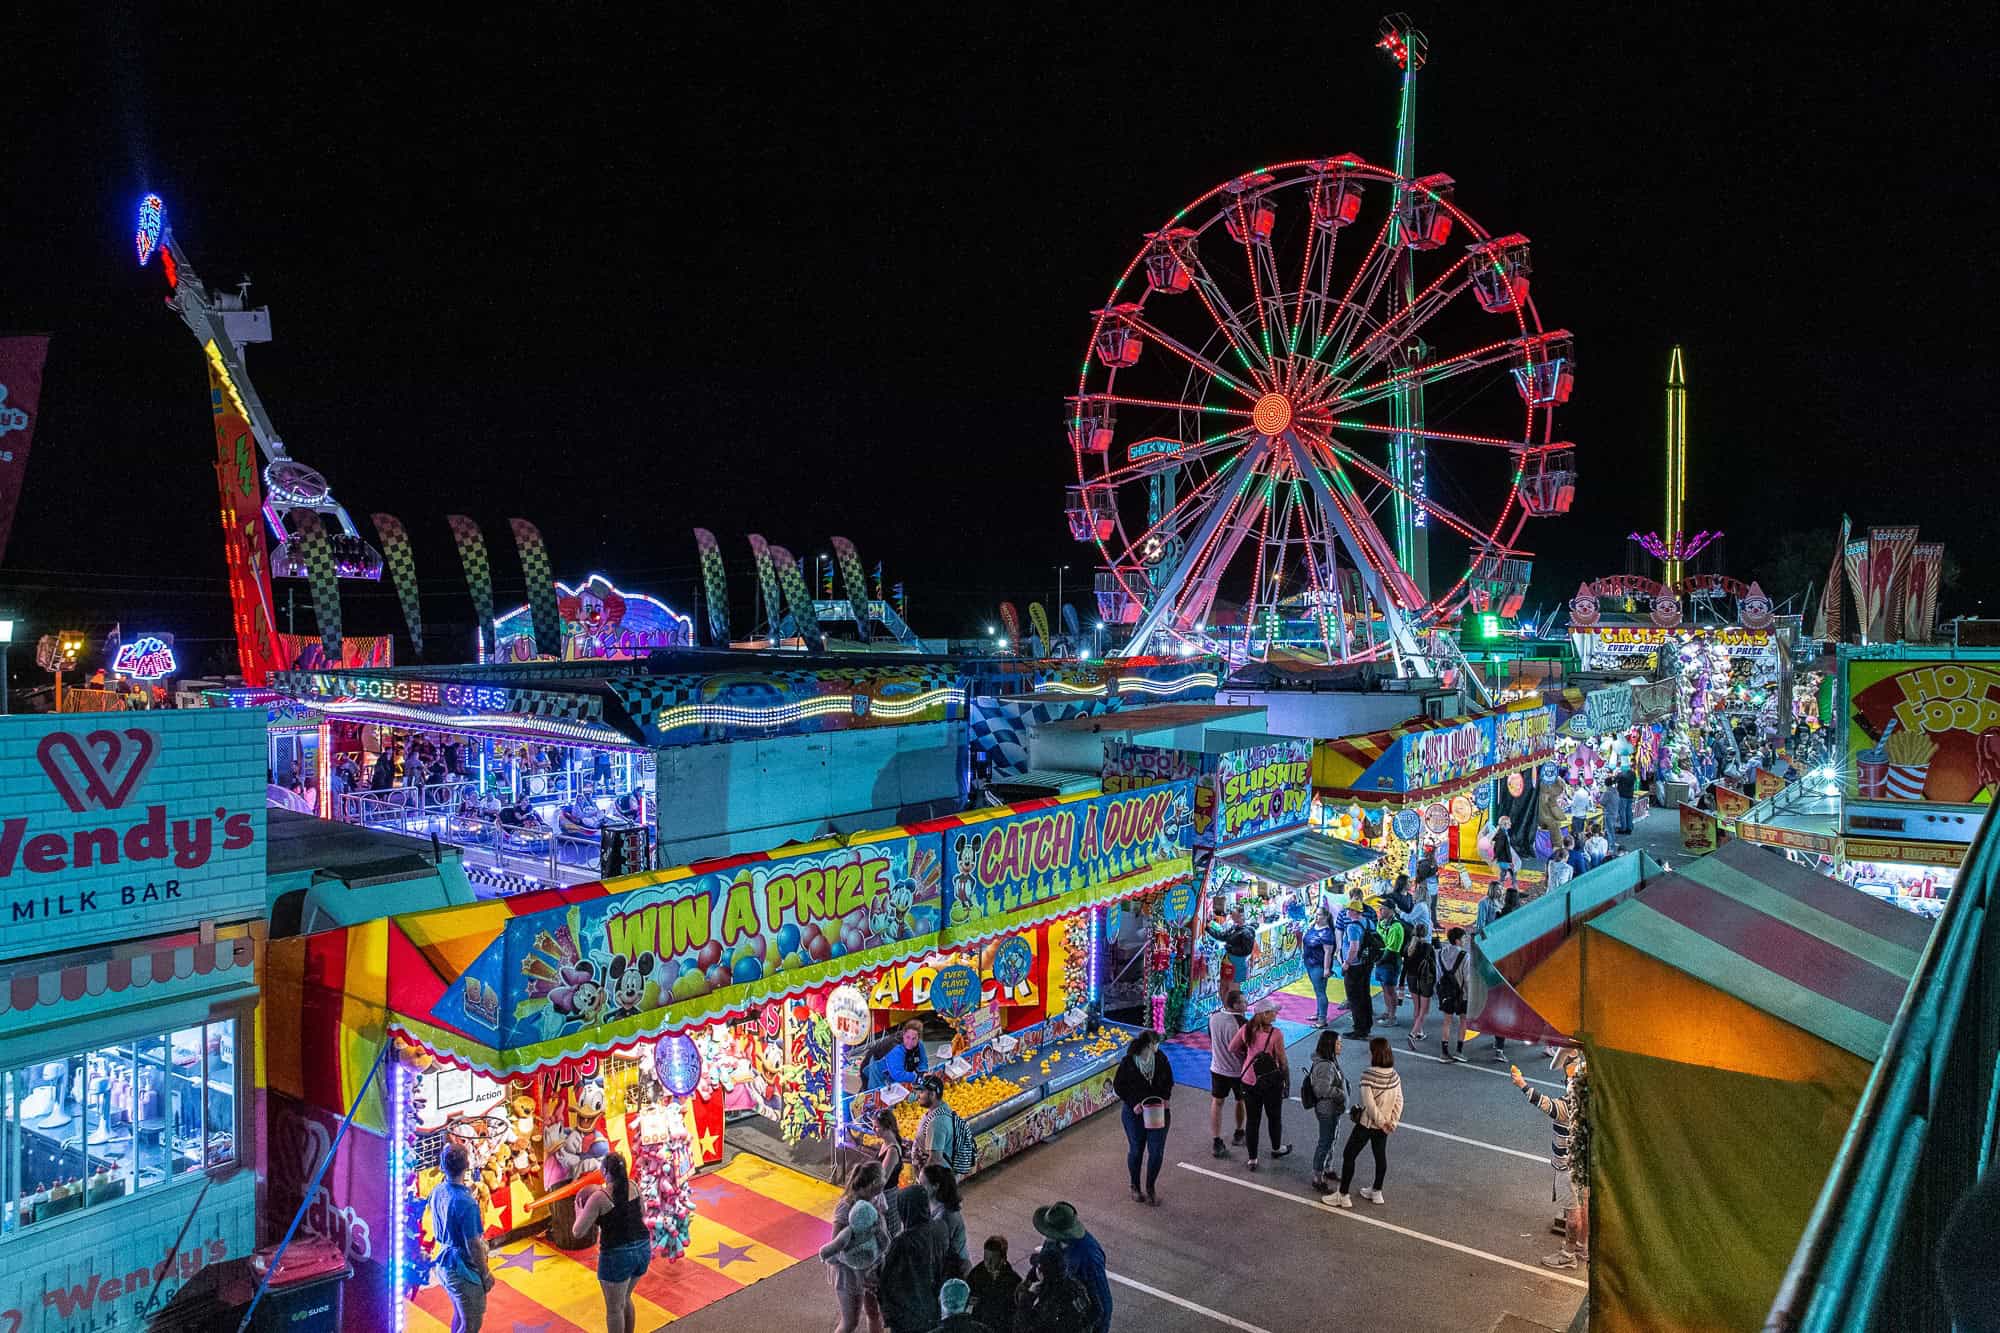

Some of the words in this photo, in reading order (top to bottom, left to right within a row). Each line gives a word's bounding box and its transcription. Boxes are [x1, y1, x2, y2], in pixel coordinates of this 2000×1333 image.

[356, 679, 439, 704] DODGEM
[447, 686, 507, 710] CARS
[1895, 664, 2000, 705] HOT
[1892, 697, 2000, 736] FOOD
[1225, 761, 1308, 803] SLUSHIE
[1225, 789, 1307, 833] FACTORY
[977, 811, 1075, 889] CATCH
[1079, 805, 1099, 862] A
[1101, 789, 1174, 856] DUCK
[12, 889, 97, 922] MILK
[121, 879, 182, 906] BAR
[606, 889, 713, 965] WIN
[723, 882, 761, 948] A
[765, 854, 892, 931] PRIZE
[941, 979, 970, 988] PLAYER
[943, 970, 968, 979] EVERY
[475, 1088, 502, 1103] Action
[42, 1237, 228, 1320] Wendy's
